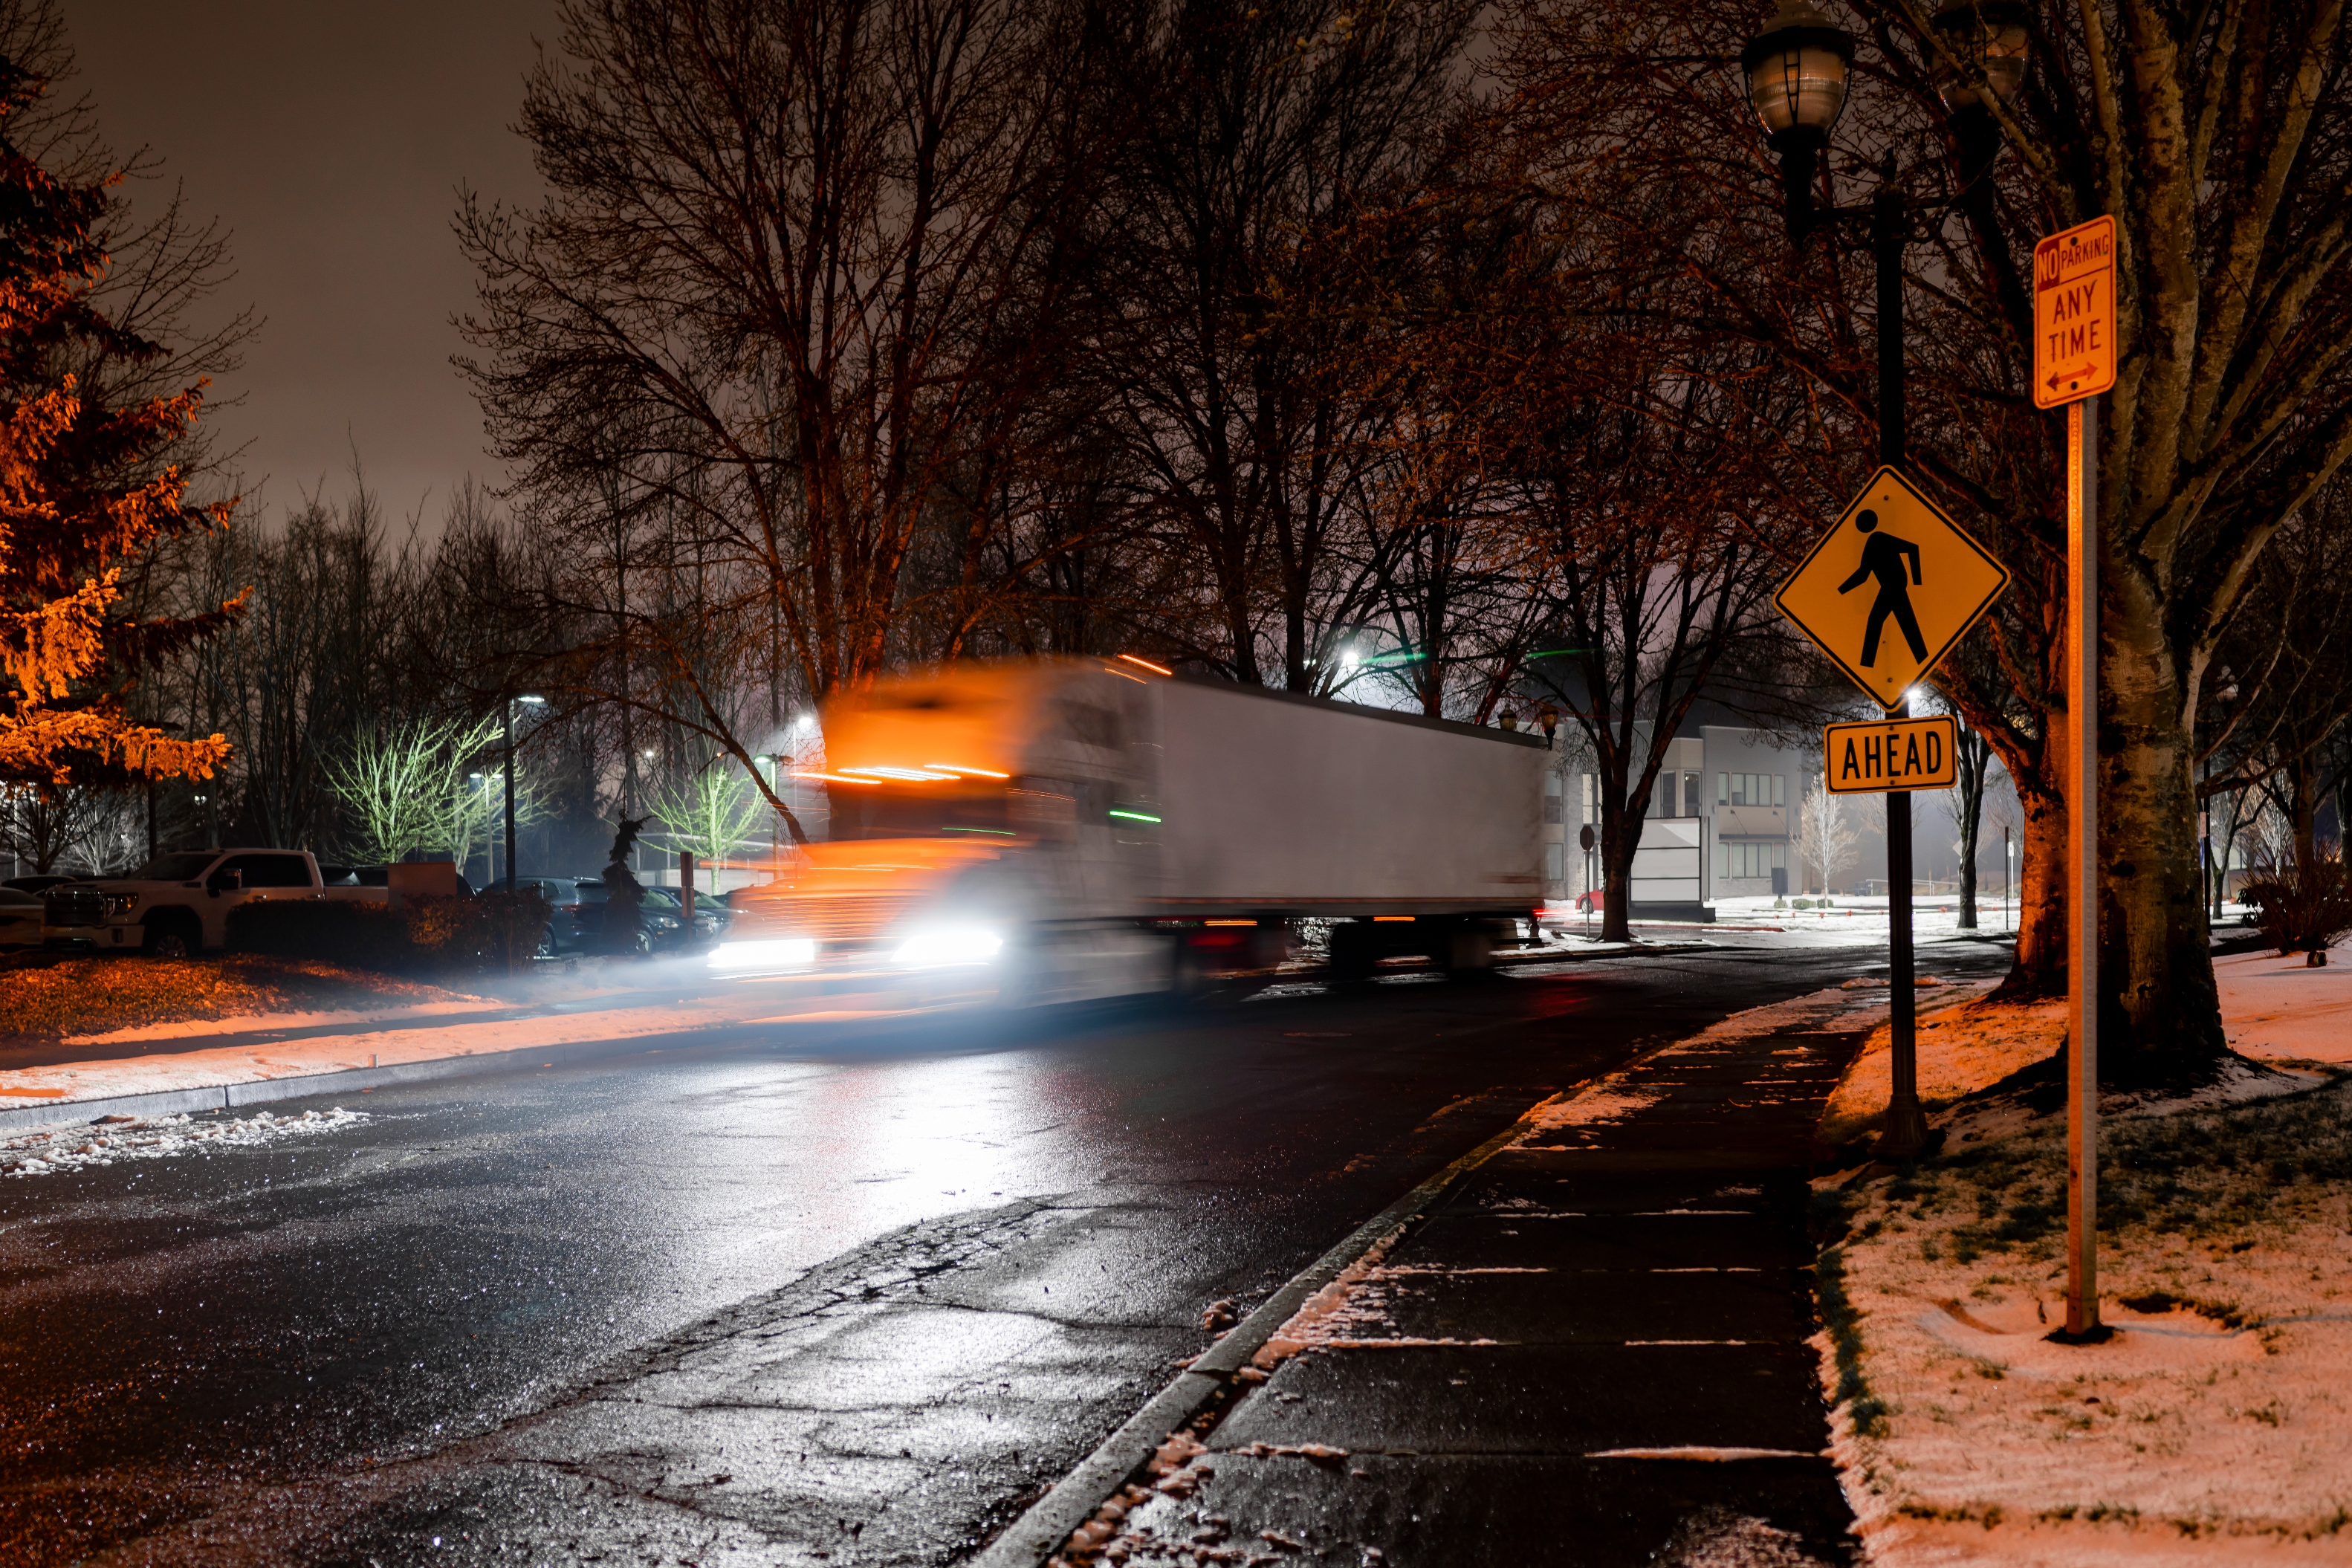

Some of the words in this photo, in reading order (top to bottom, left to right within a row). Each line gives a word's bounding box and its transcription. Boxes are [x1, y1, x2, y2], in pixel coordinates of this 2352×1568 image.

[2038, 247, 2058, 284] NO
[2061, 234, 2109, 270] PARKING
[2053, 279, 2098, 324] ANY
[2049, 319, 2102, 363] TIME
[1841, 730, 1942, 780] AHEAD
